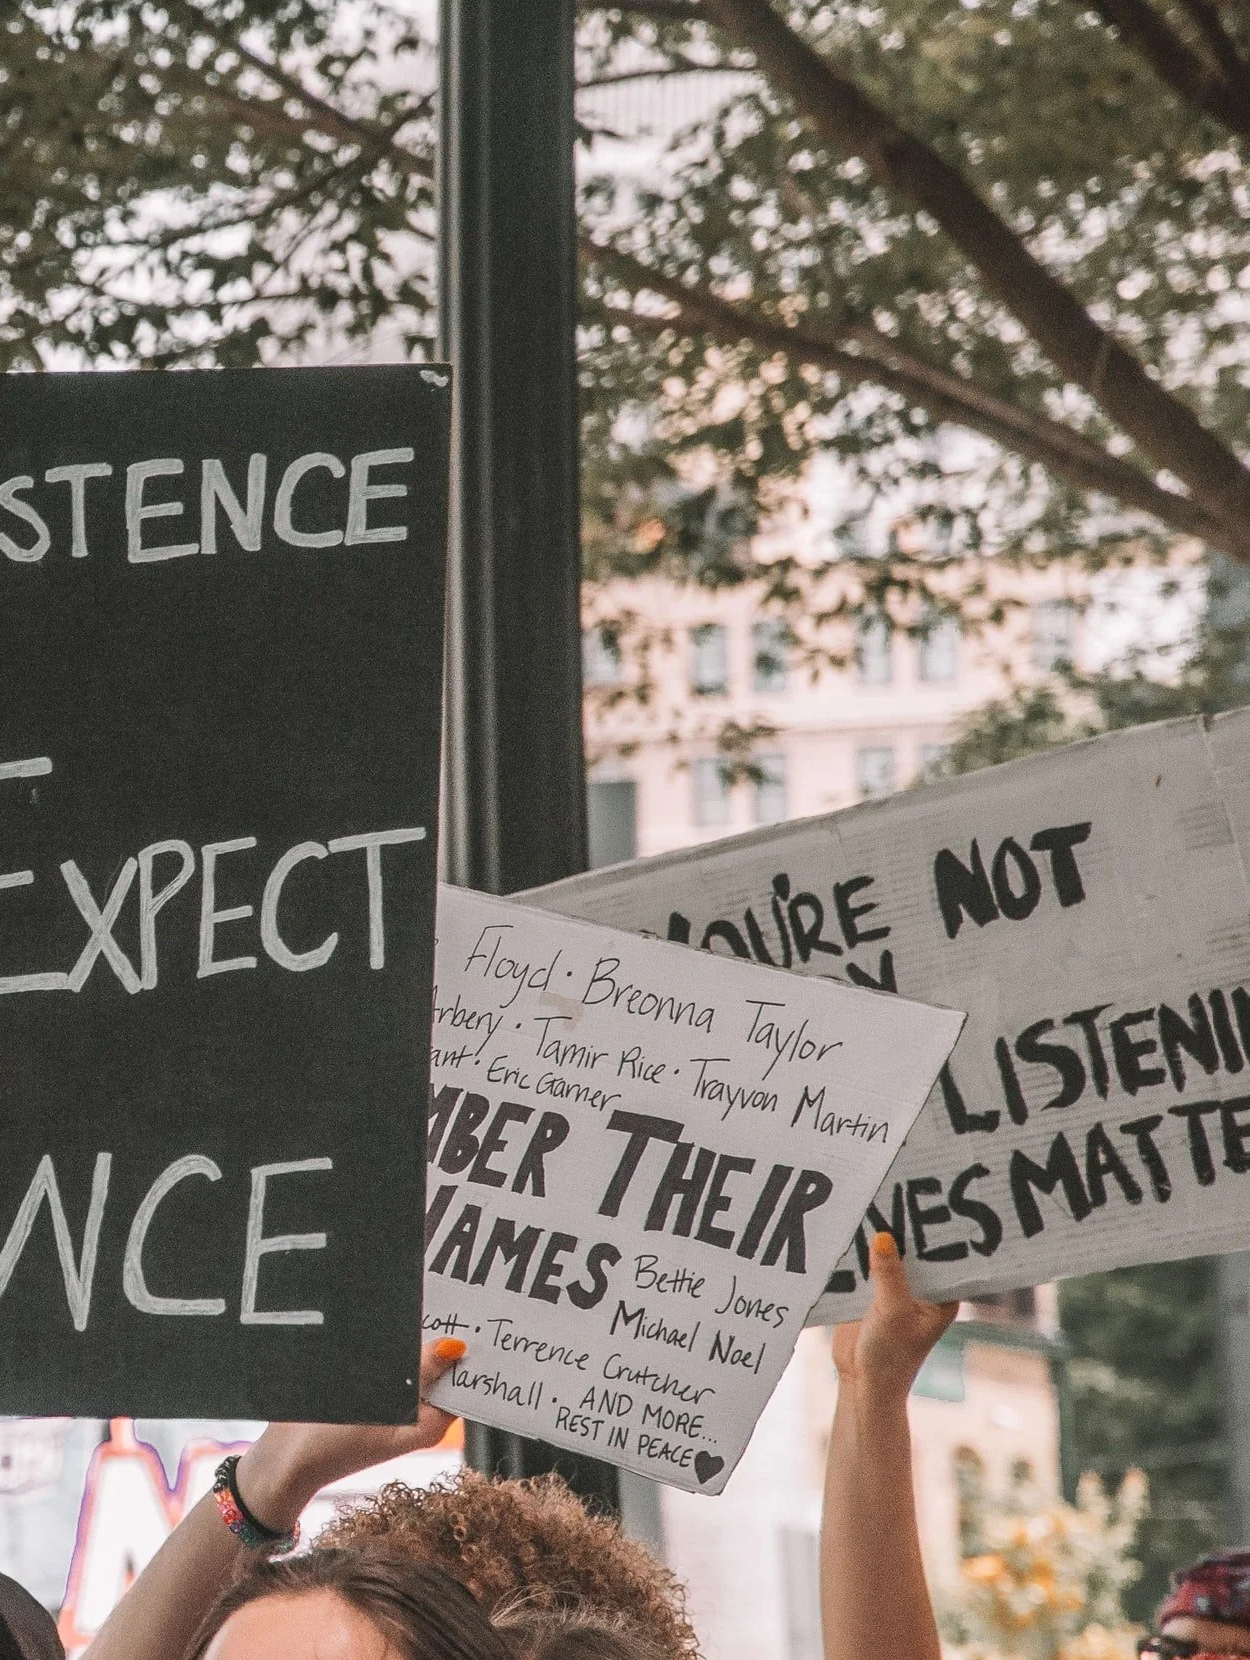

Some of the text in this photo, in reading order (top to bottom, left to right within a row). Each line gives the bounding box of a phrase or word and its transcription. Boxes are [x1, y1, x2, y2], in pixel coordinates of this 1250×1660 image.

[667, 822, 1092, 968] OU'RE NOT
[464, 925, 843, 1081] Floyd Breonna Taylor
[487, 1055, 531, 1089] Eric
[536, 1073, 622, 1111] Garner
[534, 1016, 608, 1069] Tamir
[617, 1046, 666, 1083] Rice
[690, 1058, 780, 1121] Trayvon
[791, 1086, 889, 1143] Martin
[940, 987, 1250, 1134] LISTENI
[598, 1109, 834, 1274] THEIR
[824, 1162, 1003, 1292] IVES
[610, 1300, 766, 1374] Michael Noel
[634, 1254, 789, 1328] Bettie Jones
[487, 1318, 589, 1370] Terrence
[603, 1353, 716, 1405] Crutcher
[579, 1386, 633, 1417] AND
[555, 1406, 694, 1468] REST IN PEACE
